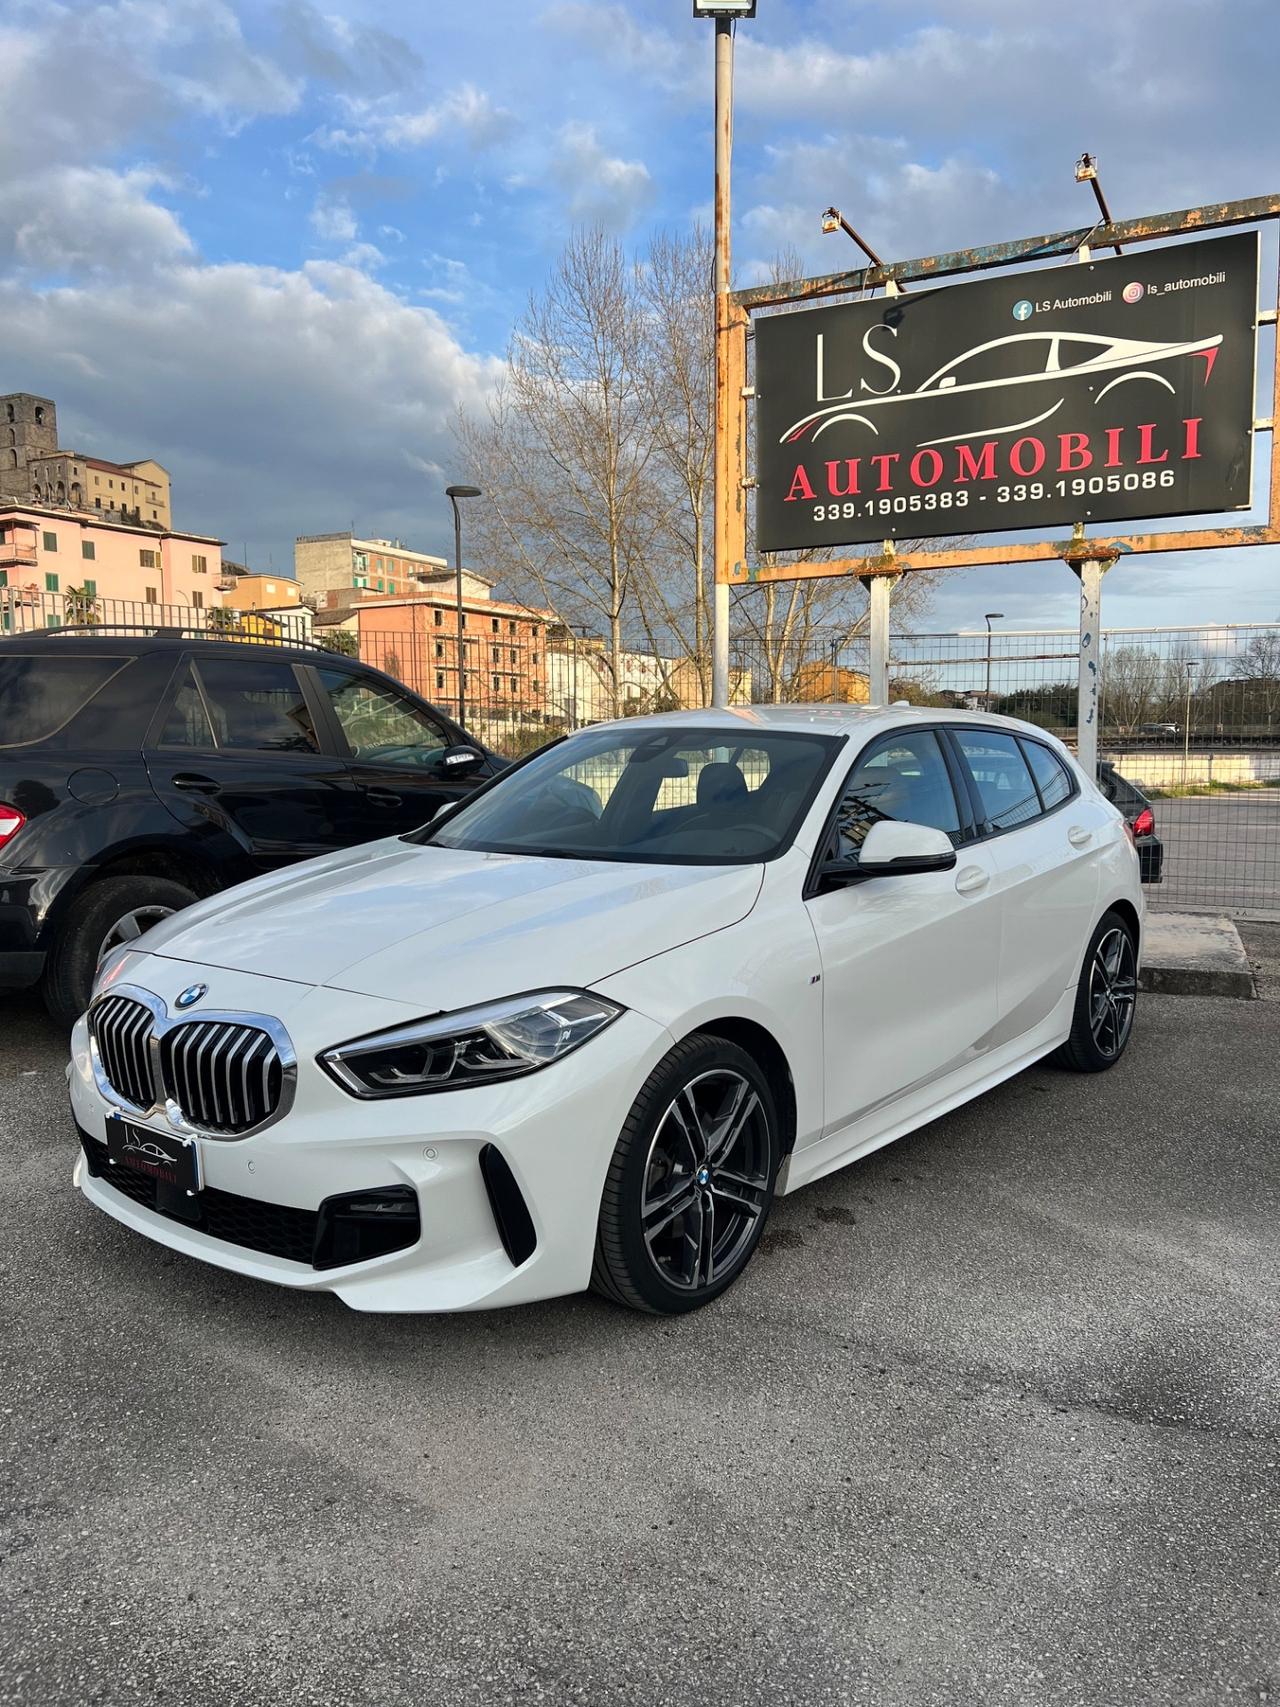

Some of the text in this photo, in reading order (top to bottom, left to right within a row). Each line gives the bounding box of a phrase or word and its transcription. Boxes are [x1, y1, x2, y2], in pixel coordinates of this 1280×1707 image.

[1035, 290, 1112, 313] LS Automobili
[1147, 271, 1226, 296] ls_automobili
[783, 418, 1203, 502] AUTOMOBILI
[813, 490, 969, 521] 339.1905383
[997, 470, 1175, 503] 339.1905086
